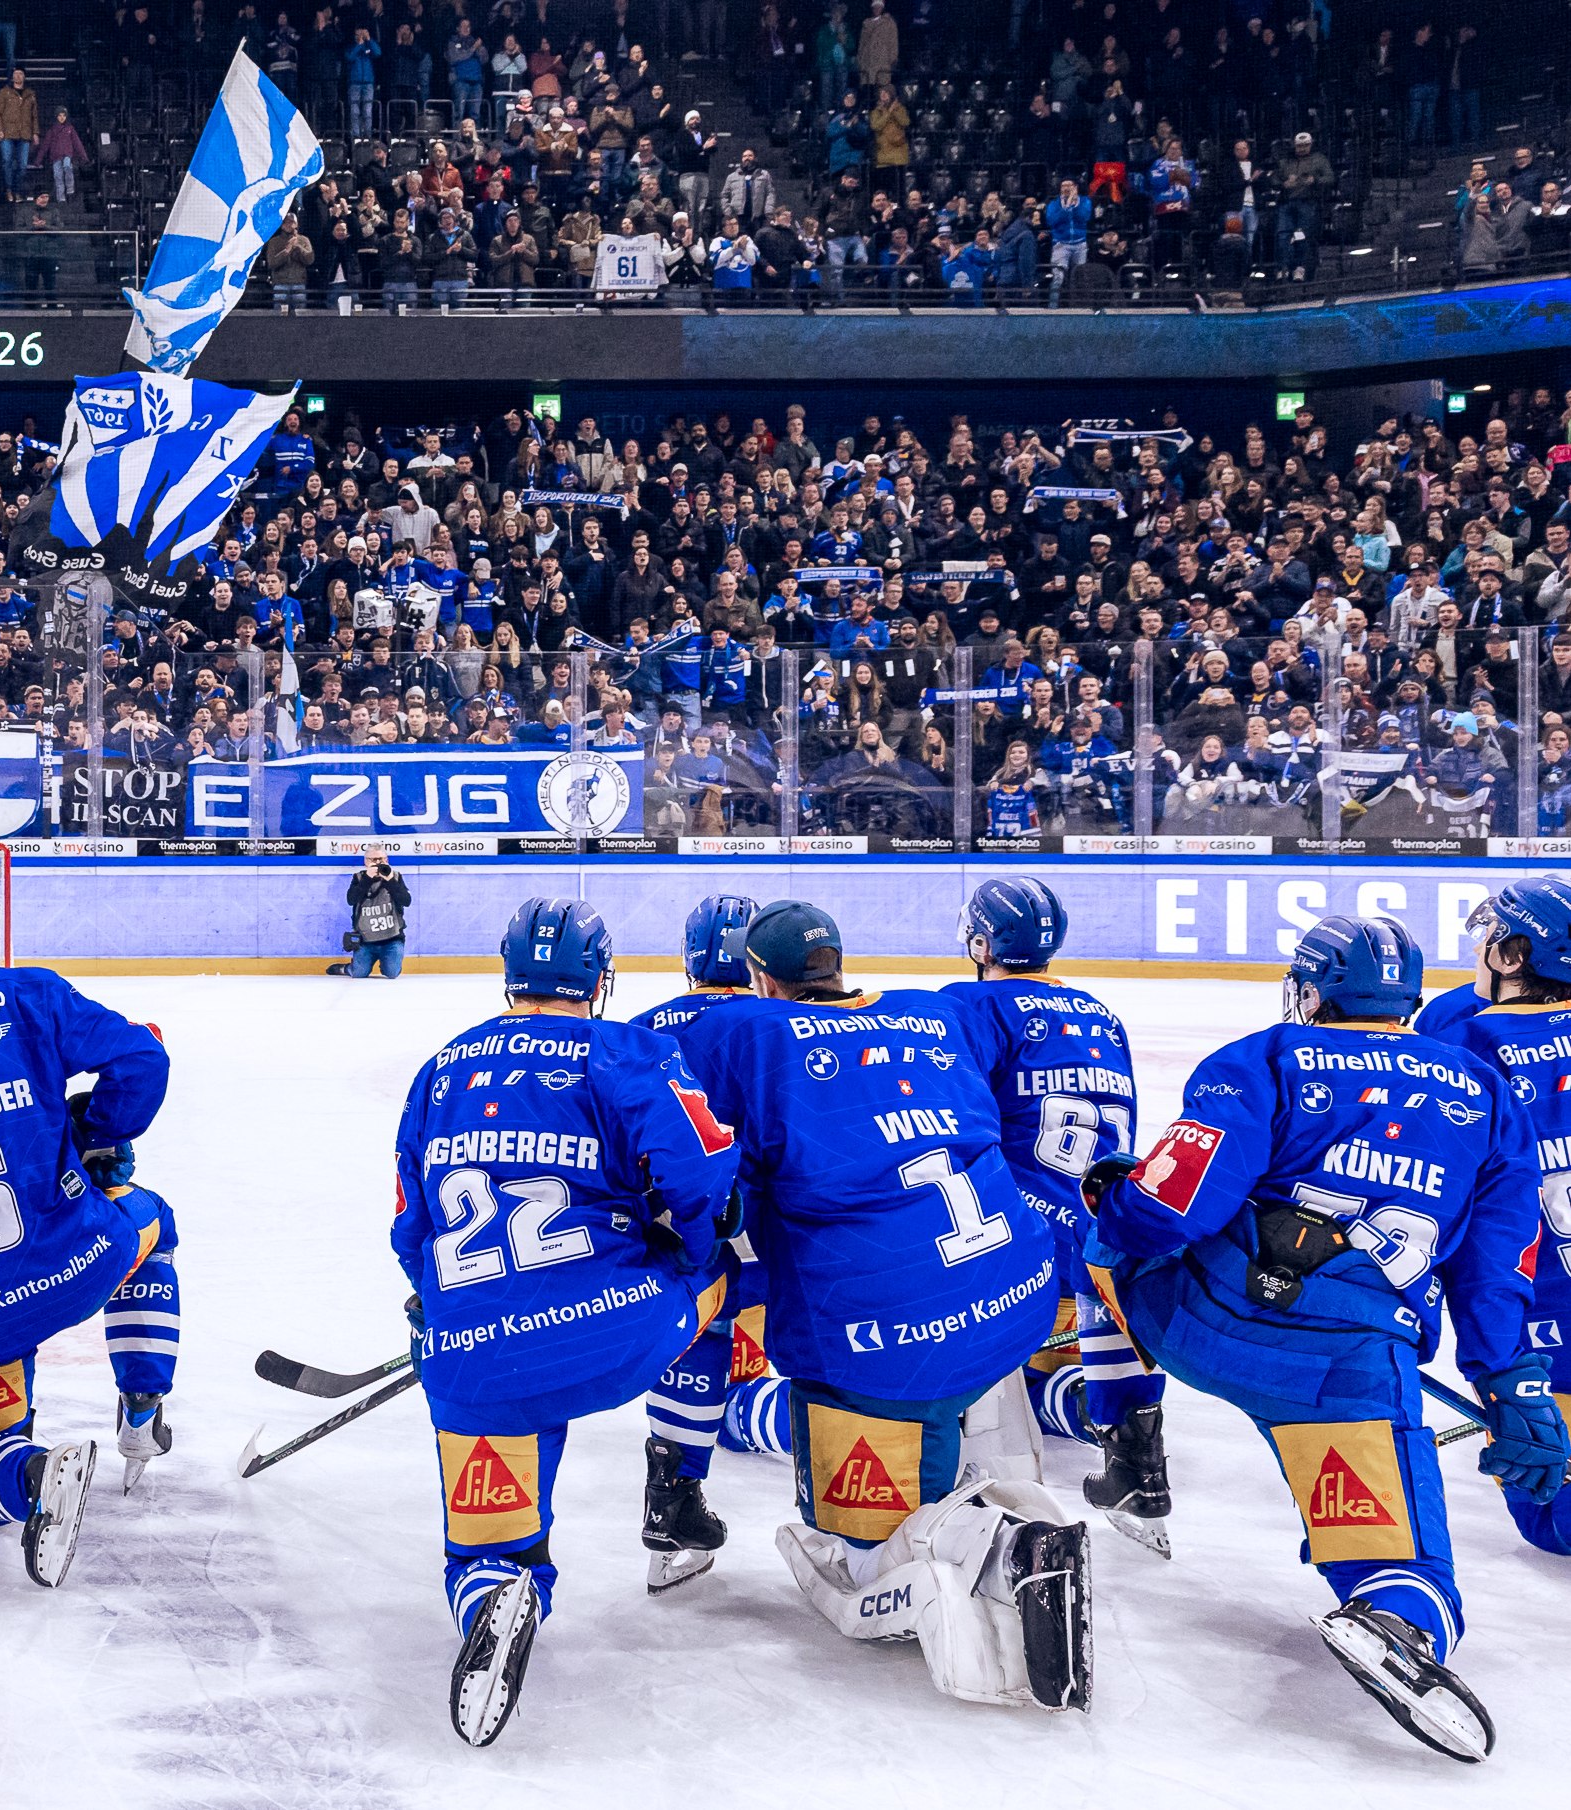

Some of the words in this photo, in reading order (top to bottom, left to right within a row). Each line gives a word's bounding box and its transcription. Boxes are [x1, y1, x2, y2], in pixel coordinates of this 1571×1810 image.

[617, 255, 638, 278] 61
[599, 495, 622, 506] ZUG
[1106, 757, 1155, 773] EVZ
[74, 766, 182, 802] STOP
[310, 773, 511, 828] ZUG
[58, 843, 124, 855] mycasino
[158, 841, 217, 852] thermoplan
[424, 841, 484, 854] mycasino
[890, 838, 953, 849] thermoplan
[1091, 839, 1159, 852] mycasino
[1186, 839, 1256, 852] mycasino
[1390, 838, 1461, 851] thermoplan
[369, 915, 395, 932] 230
[1040, 916, 1052, 927] 61
[1156, 878, 1490, 961] EISSP
[538, 926, 555, 938] 22
[804, 927, 829, 942] EVZ
[1380, 944, 1396, 956] 73
[555, 985, 584, 997] CCM
[1014, 996, 1073, 1015] Binelli
[789, 1015, 877, 1041] Binelli
[877, 1013, 948, 1040] Group
[435, 1034, 505, 1072] Binelli
[507, 1032, 591, 1063] Group
[1497, 1035, 1571, 1066] Binell
[1294, 1046, 1394, 1072] Binelli
[1396, 1052, 1482, 1098] Group
[873, 1107, 959, 1144] WOLF
[1323, 1138, 1446, 1198] KÜNZLE
[898, 1148, 1013, 1267] 1
[433, 1168, 594, 1291] 22
[965, 1233, 985, 1244] CCM
[894, 1310, 969, 1345] Zuger
[970, 1256, 1056, 1324] Kantonalb
[1263, 1290, 1276, 1300] 88
[440, 1323, 497, 1352] Zuger
[501, 1276, 662, 1337] Kantonalbank
[455, 1458, 518, 1507] Sika
[833, 1459, 894, 1504] Sika
[1312, 1472, 1378, 1520] Sika
[860, 1583, 912, 1618] CCM
